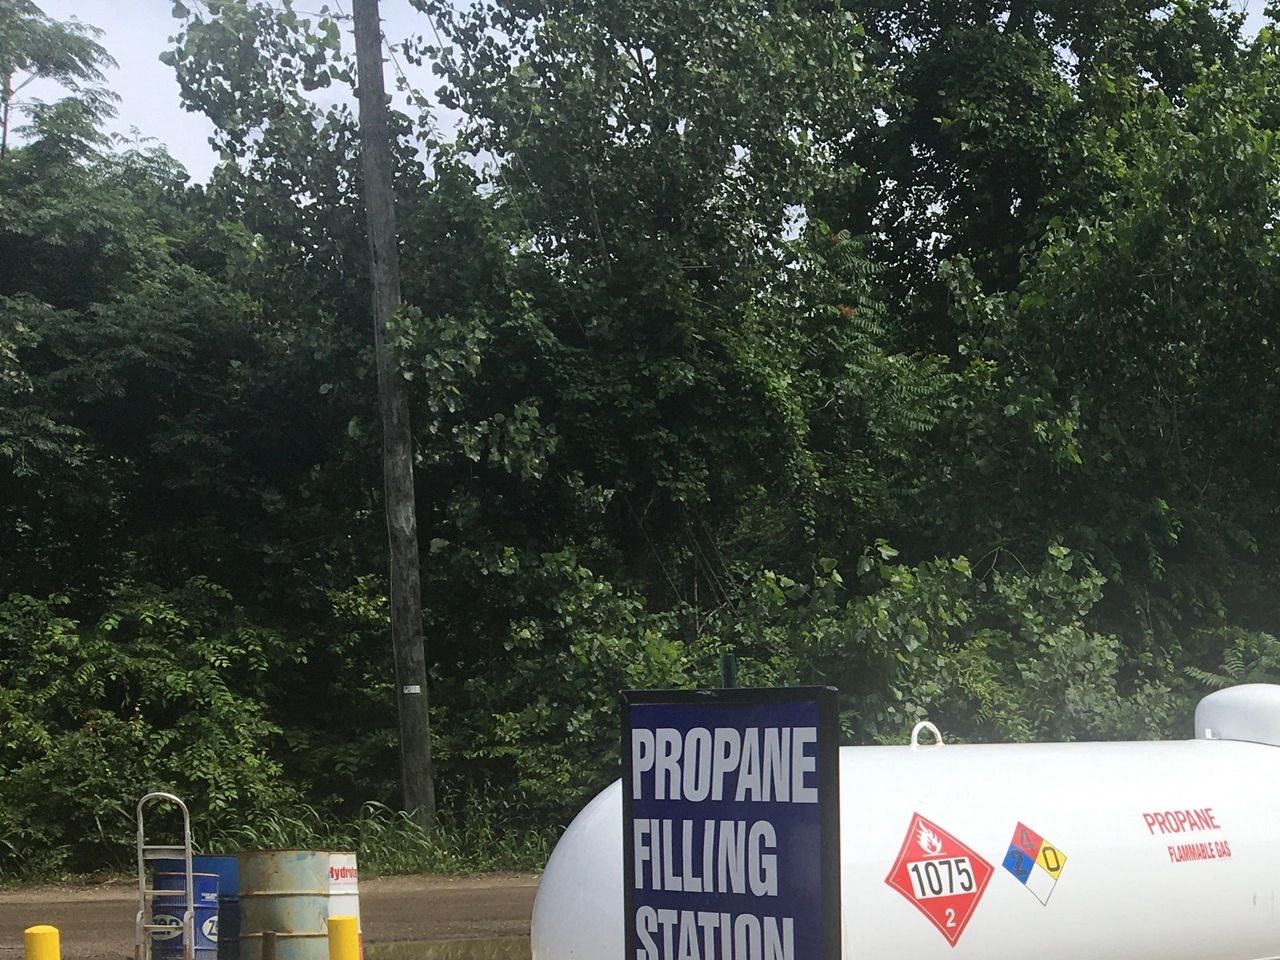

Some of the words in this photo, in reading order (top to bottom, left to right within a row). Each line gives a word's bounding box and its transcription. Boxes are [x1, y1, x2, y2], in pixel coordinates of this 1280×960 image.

[631, 727, 818, 803] PROPANE
[1142, 807, 1221, 835] PROPANE
[1020, 829, 1035, 851] 4
[1168, 841, 1216, 863] FLAMMABLE
[1214, 840, 1232, 858] GAS
[633, 818, 778, 897] FILLING
[1010, 850, 1028, 876] 2
[1042, 846, 1060, 872] 0
[911, 858, 973, 897] 1075
[945, 908, 957, 928] 2
